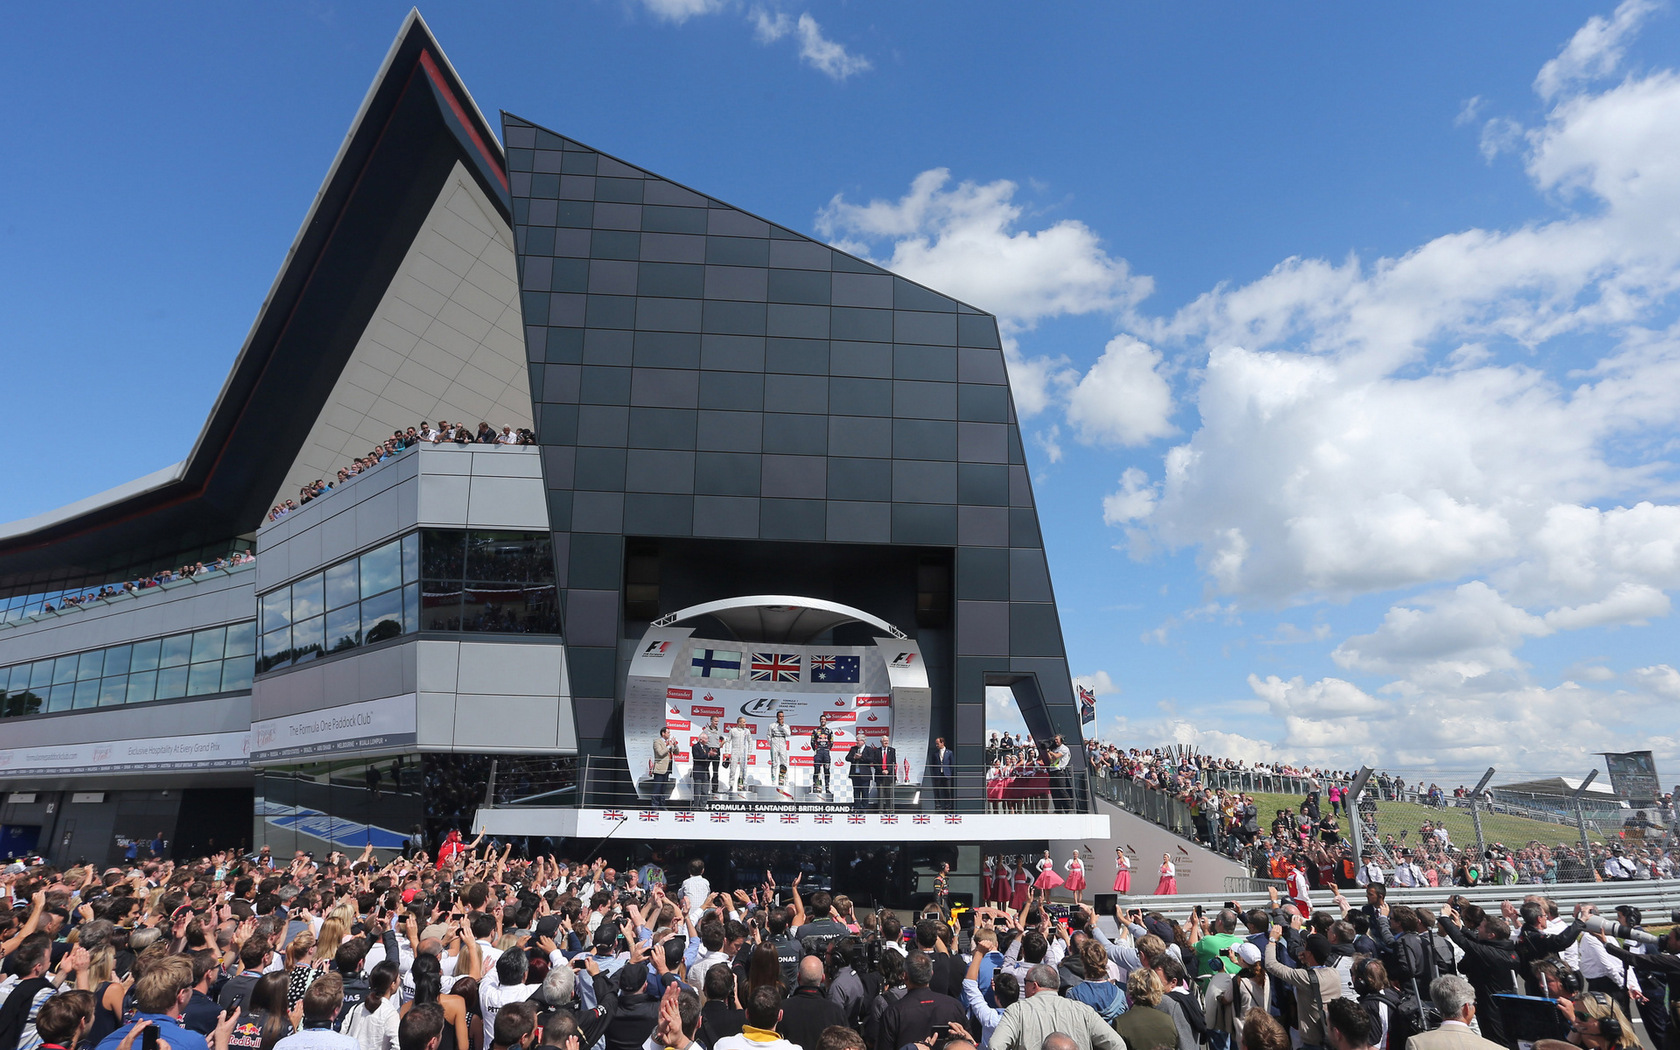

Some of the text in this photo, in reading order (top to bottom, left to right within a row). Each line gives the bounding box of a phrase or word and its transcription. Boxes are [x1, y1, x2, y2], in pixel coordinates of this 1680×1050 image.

[668, 690, 691, 698] Santander
[699, 708, 723, 716] Santander
[289, 725, 299, 736] The
[299, 722, 320, 735] Formula
[320, 719, 332, 732] One
[332, 715, 356, 730] Paddock
[356, 712, 371, 726] Club
[666, 721, 690, 729] Santander
[128, 742, 221, 756] Exclusive Hospitality At Every Grand Prix
[755, 804, 796, 812] SANTANDER
[825, 805, 850, 813] GRAND
[229, 1035, 262, 1048] Red Bull
